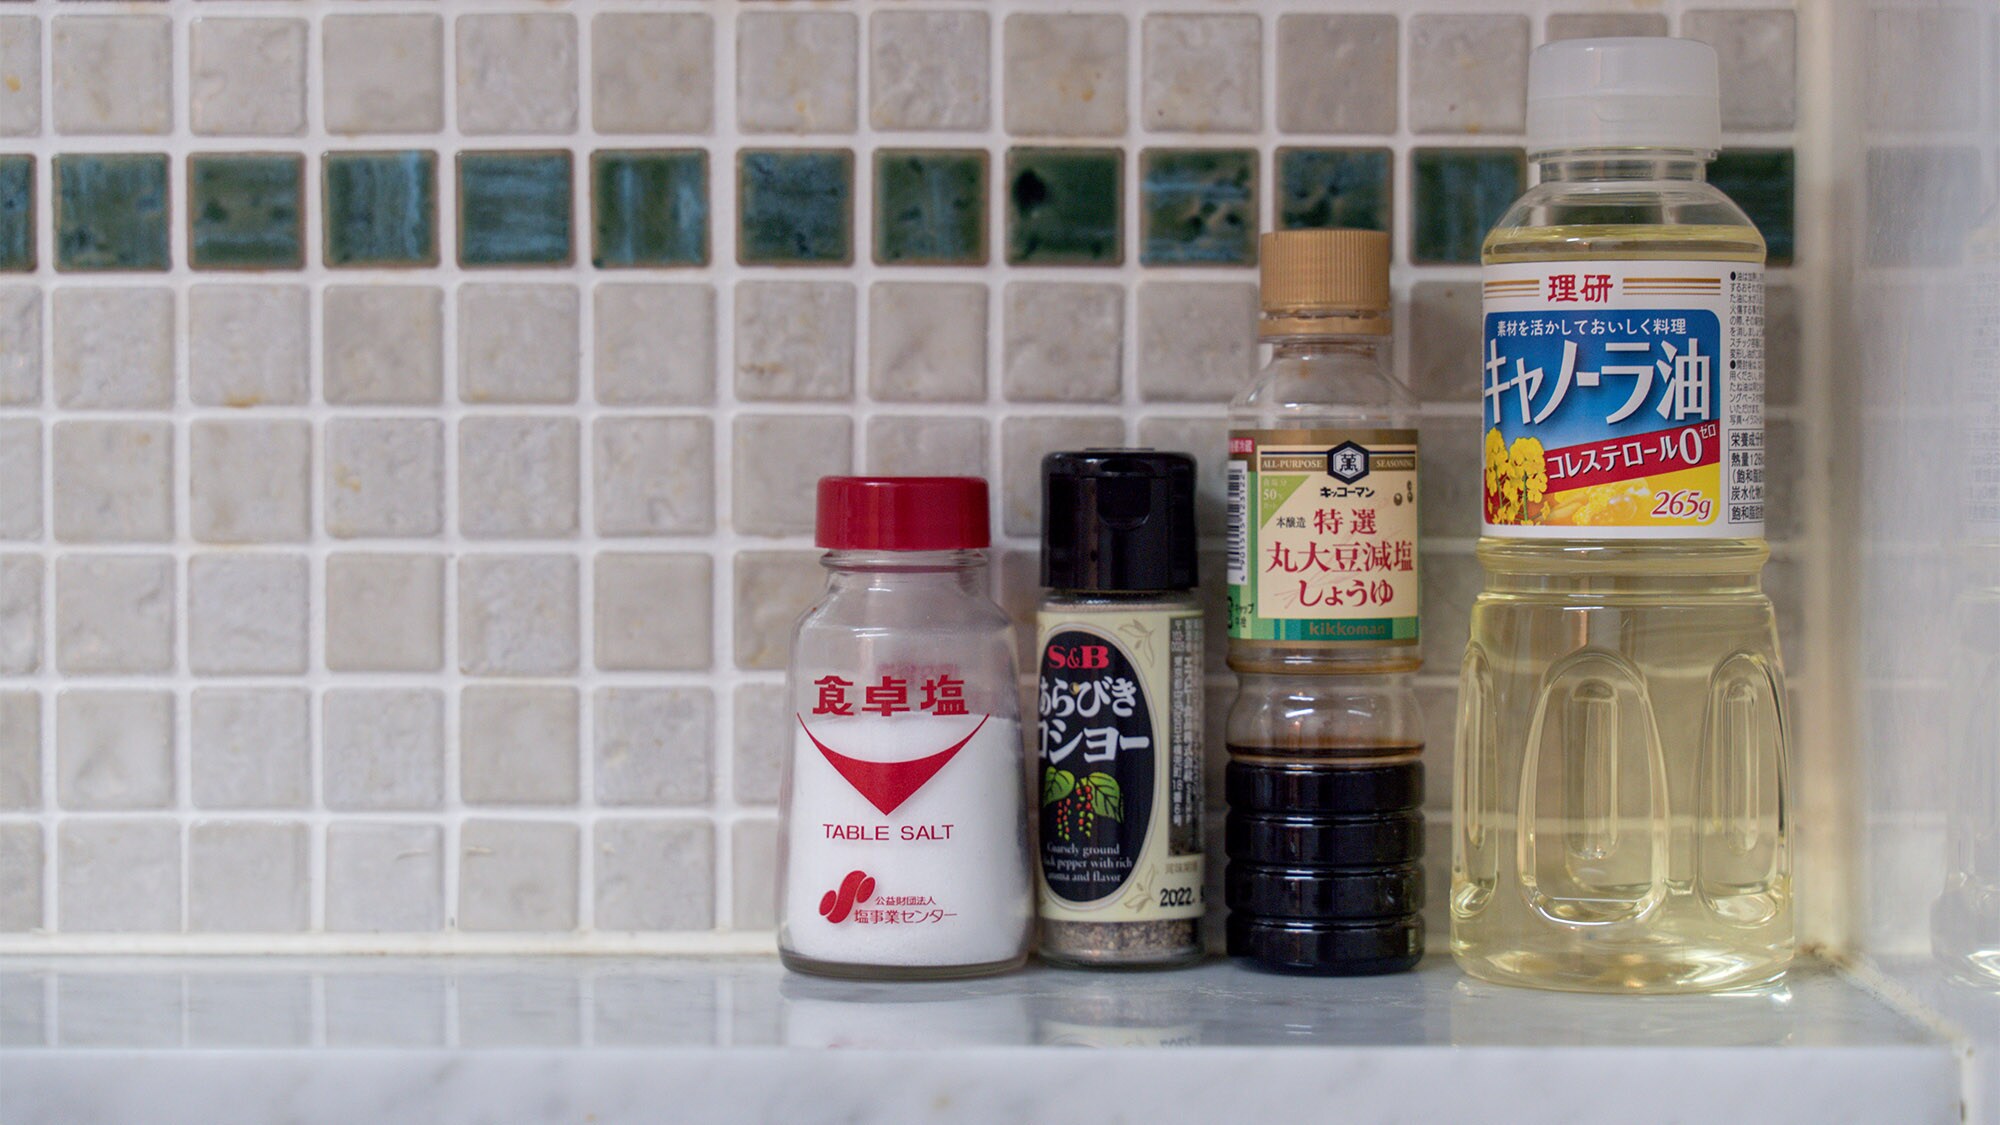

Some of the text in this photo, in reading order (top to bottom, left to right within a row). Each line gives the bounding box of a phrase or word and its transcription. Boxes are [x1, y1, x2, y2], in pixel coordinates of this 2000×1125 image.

[1547, 273, 1614, 304] 理研
[1497, 318, 1687, 337] 素材を活かしておいしく料理
[1484, 337, 1711, 425] キャノーラ油
[1699, 425, 1717, 439] ゼロ
[1263, 459, 1323, 469] ALL-PURPOSE
[1320, 487, 1375, 498] キッコーマン
[1650, 490, 1712, 520] 265g
[1276, 508, 1377, 535] 本醸造 特選
[1266, 540, 1414, 573] 丸大豆減塩
[1299, 579, 1394, 607] しょうゆ
[1309, 622, 1386, 635] kikkoman
[1047, 645, 1110, 669] S&B
[812, 674, 969, 717] 食卓塩
[1039, 675, 1137, 717] あらびき
[823, 824, 954, 841] TABLE SALT
[1082, 843, 1120, 856] ground
[1057, 859, 1087, 871] pepper
[1091, 857, 1114, 869] with
[1115, 856, 1133, 869] rich
[1072, 870, 1090, 882] and
[1093, 870, 1121, 882] flavor
[875, 896, 936, 906] 公益財団法人
[854, 909, 958, 925] 塩事業センター
